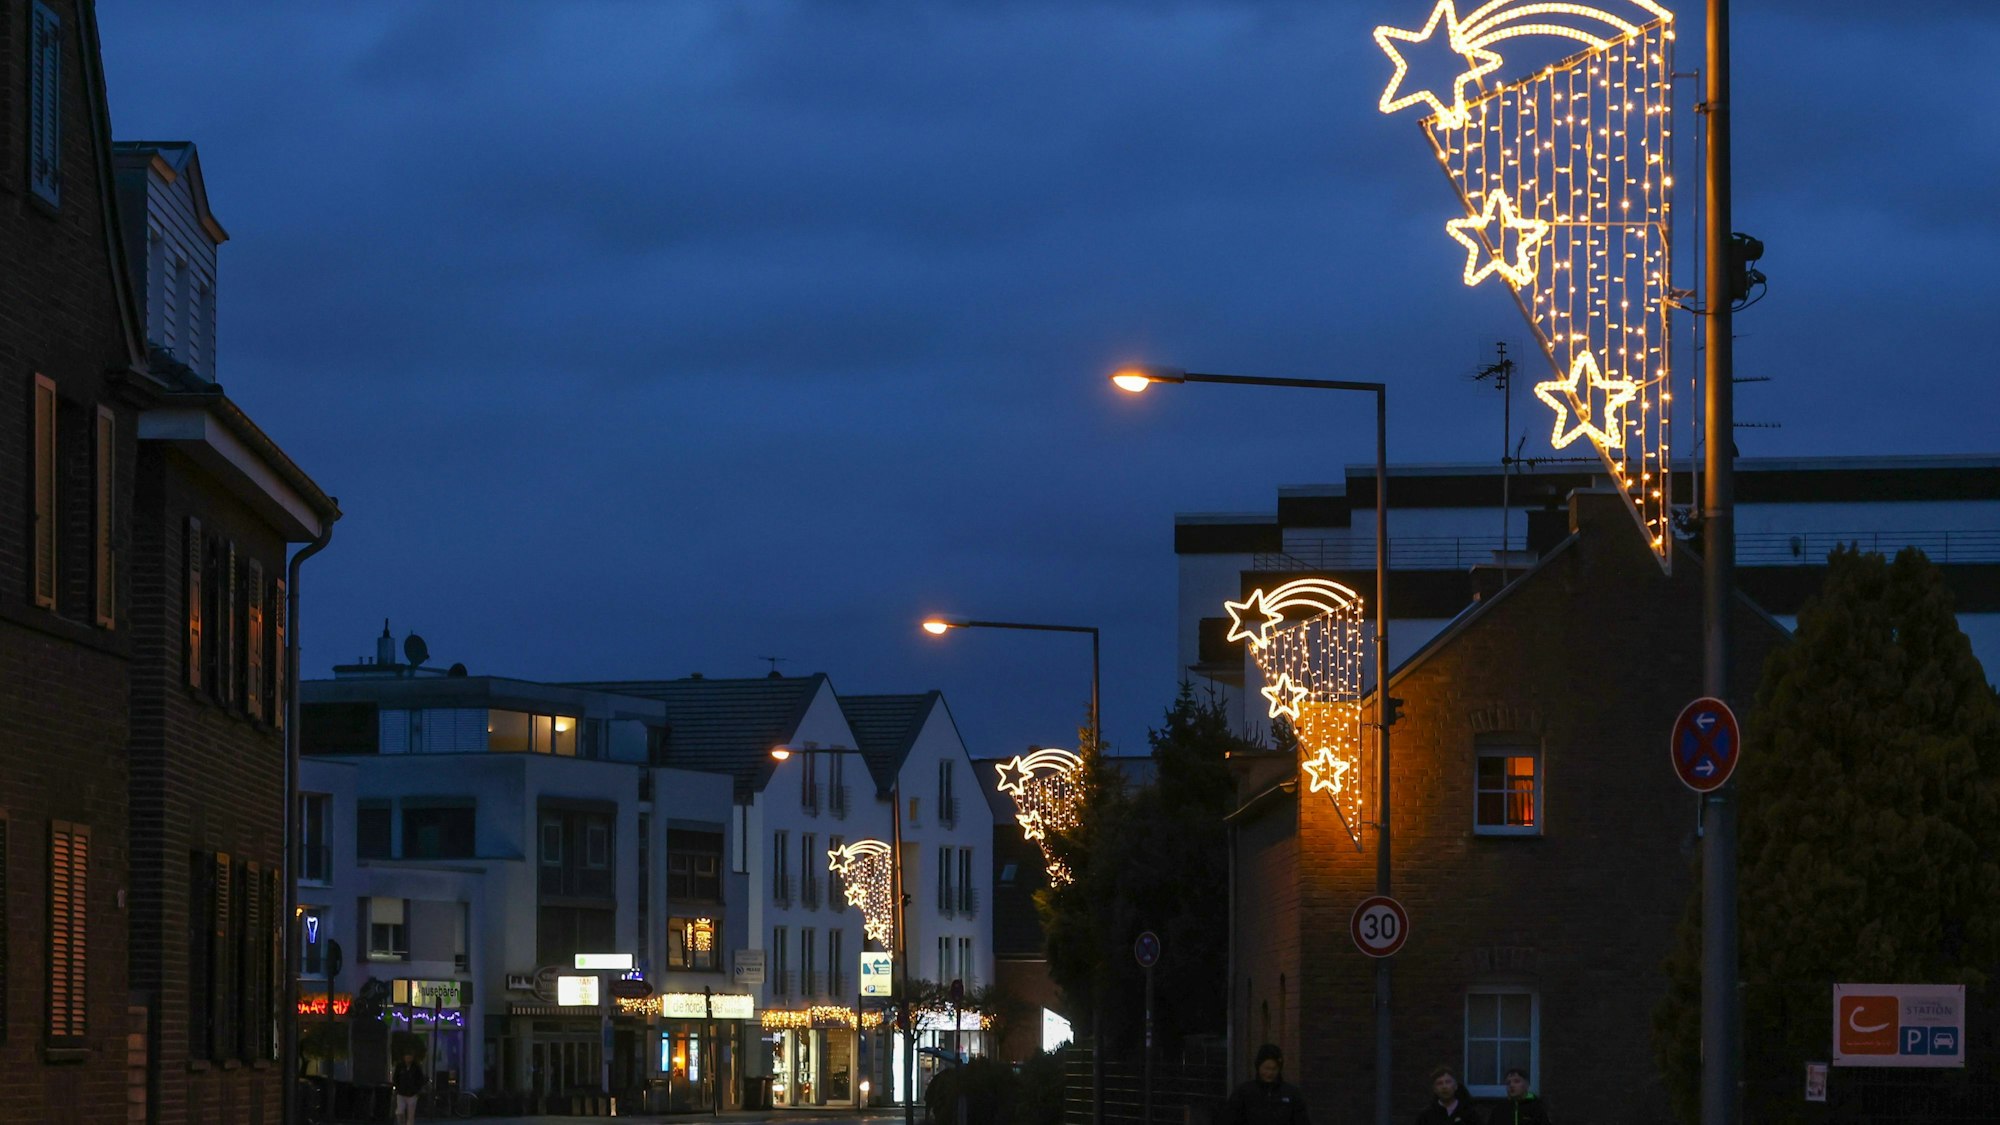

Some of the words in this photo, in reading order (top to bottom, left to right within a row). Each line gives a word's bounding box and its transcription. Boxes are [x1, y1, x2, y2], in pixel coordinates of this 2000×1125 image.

[1364, 913, 1395, 940] 30
[297, 999, 351, 1015] AARRIX
[1905, 1005, 1952, 1016] STATION
[1908, 1029, 1922, 1053] P
